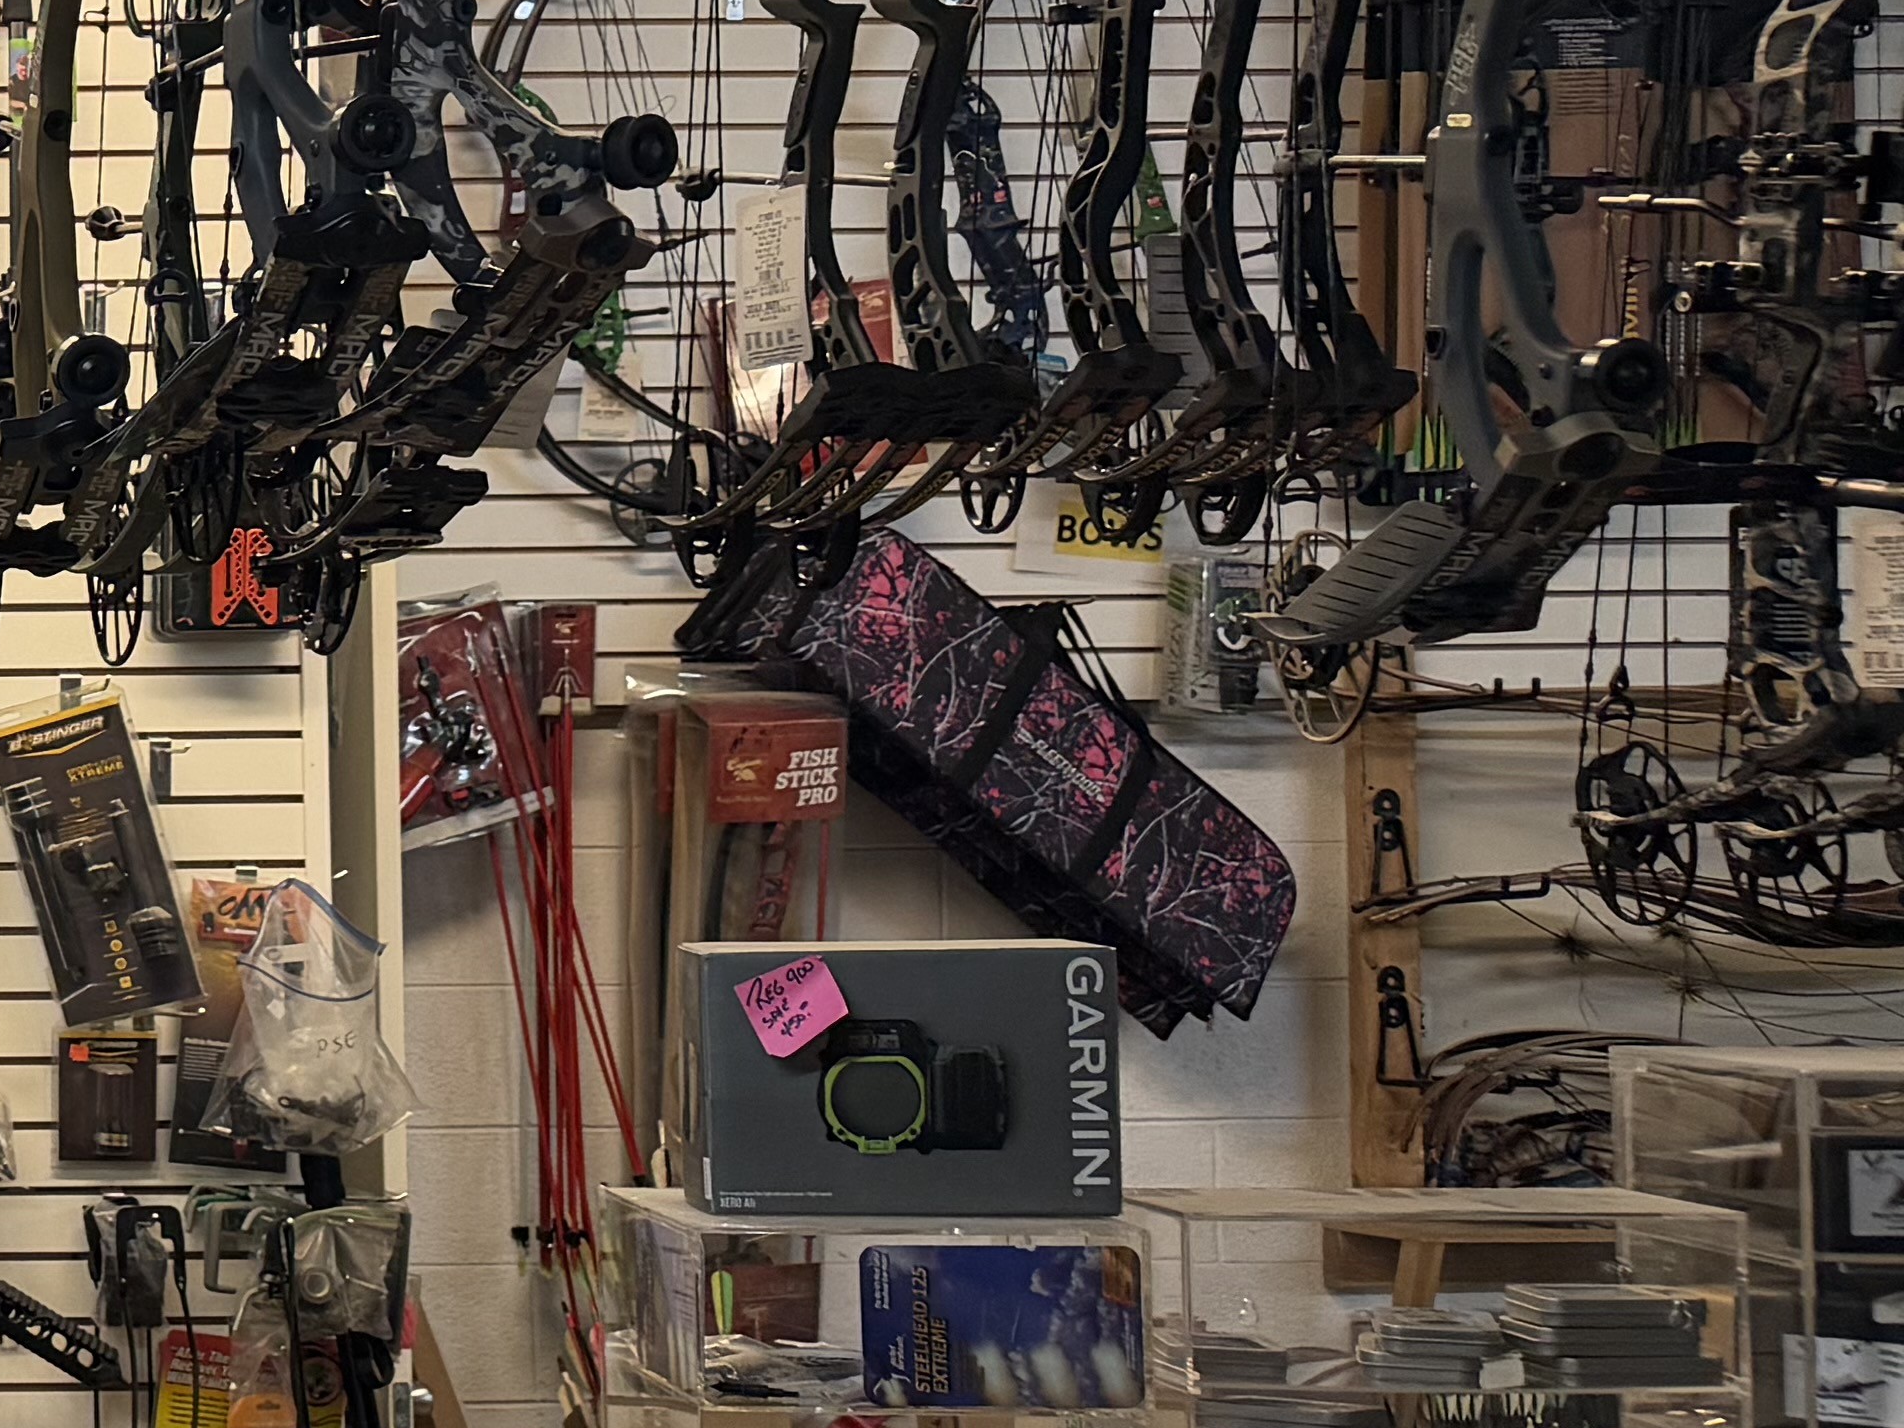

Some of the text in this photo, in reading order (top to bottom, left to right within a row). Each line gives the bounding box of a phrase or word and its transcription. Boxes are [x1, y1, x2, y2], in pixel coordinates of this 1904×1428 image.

[774, 766, 839, 789] STICK
[789, 748, 840, 770] FISH
[795, 785, 838, 806] PRO
[1064, 956, 1112, 1186] GARMIN
[914, 1303, 932, 1394] STEELHEAD
[932, 1316, 950, 1394] EXTREME
